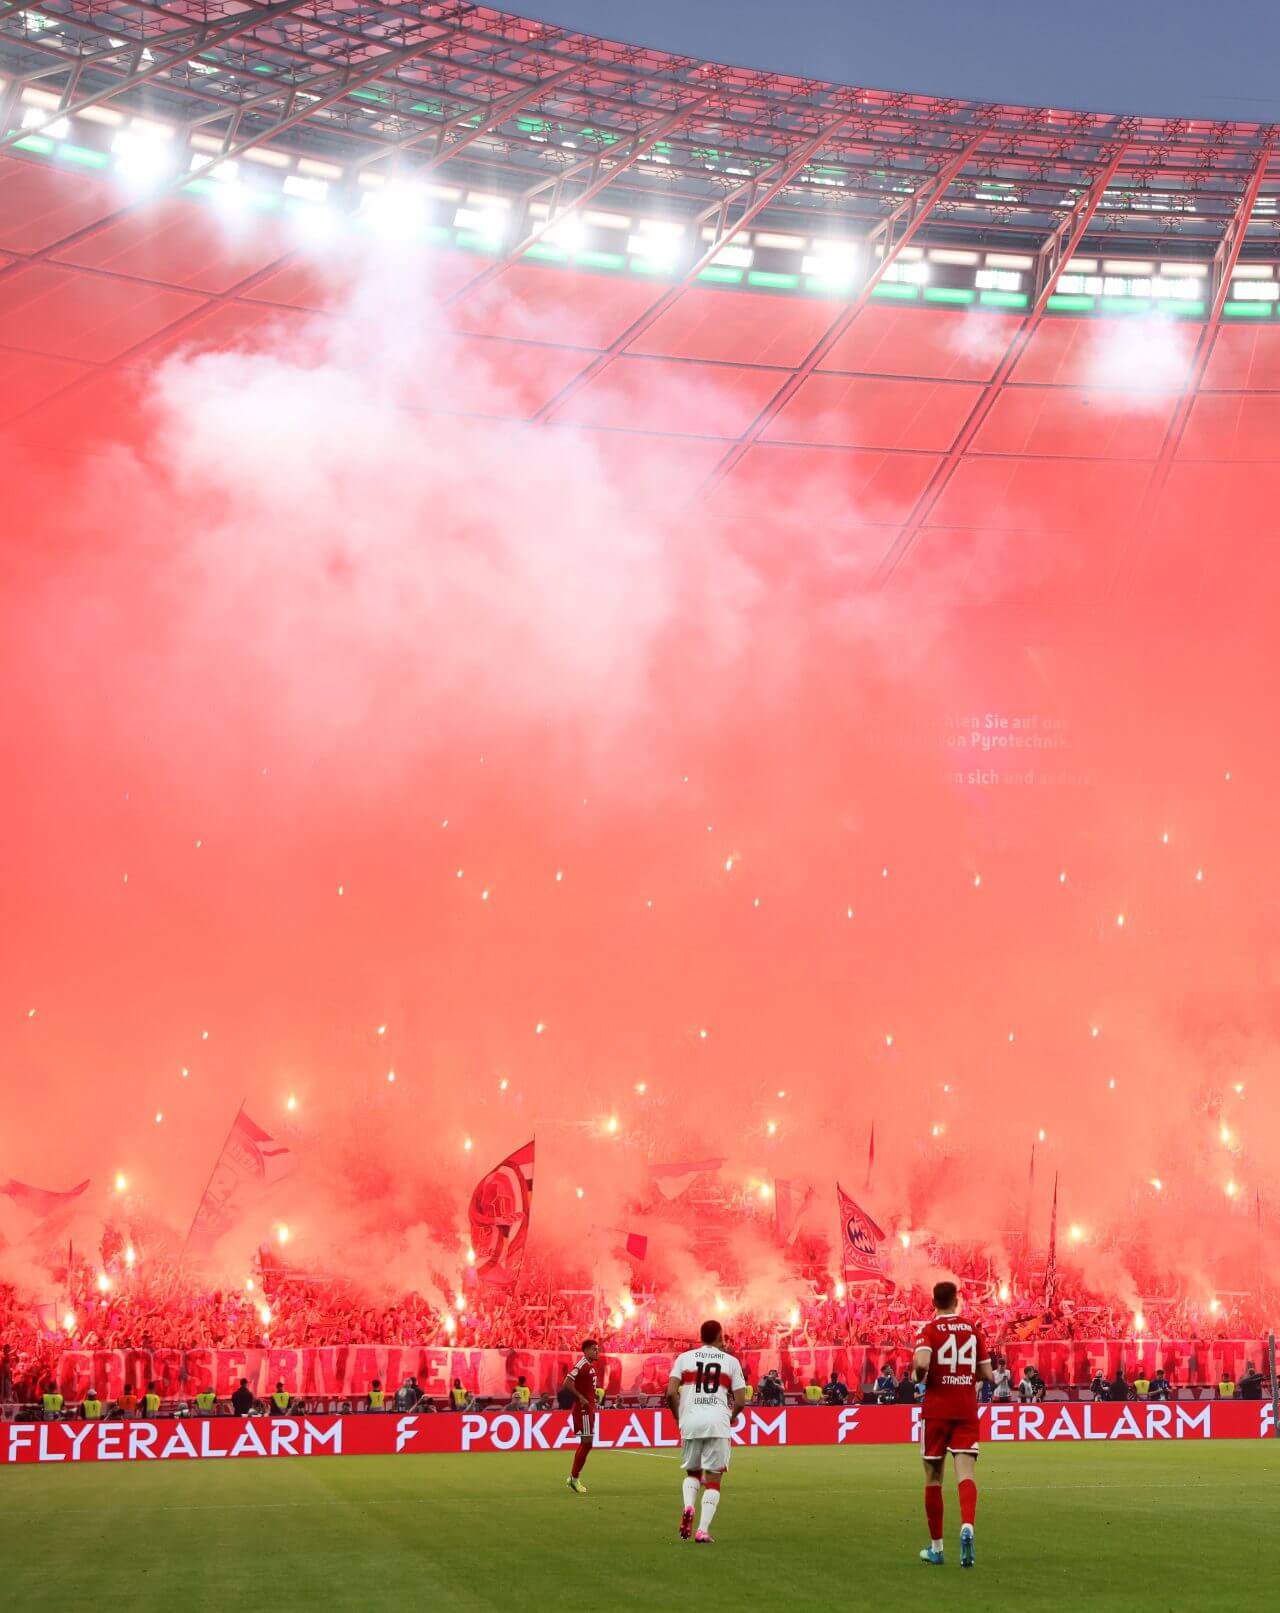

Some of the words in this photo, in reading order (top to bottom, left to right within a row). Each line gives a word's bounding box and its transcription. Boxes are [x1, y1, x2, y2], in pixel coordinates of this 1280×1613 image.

[984, 713, 1009, 729] Sie
[967, 769, 999, 785] sich
[936, 1323, 947, 1332] FC
[948, 1323, 973, 1331] BAYERN
[937, 1333, 977, 1374] 44
[8, 1418, 343, 1462] FLYERALARM
